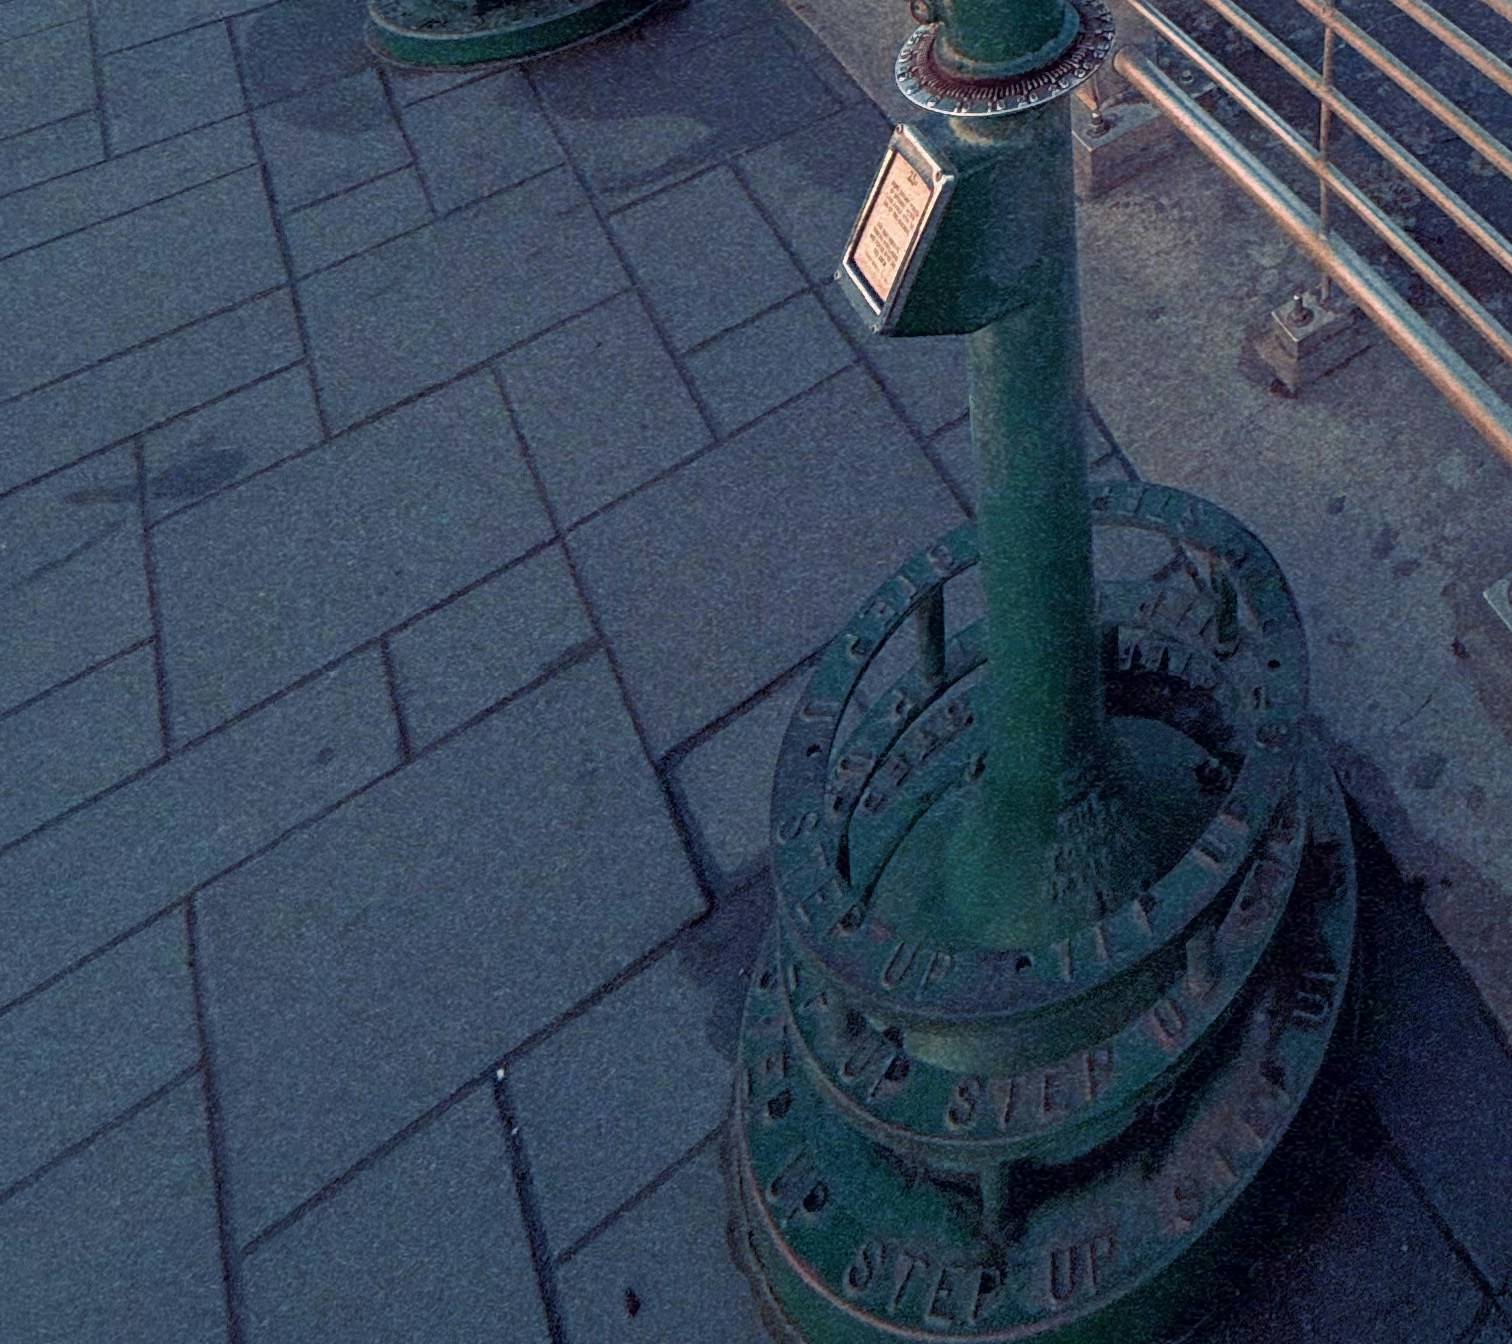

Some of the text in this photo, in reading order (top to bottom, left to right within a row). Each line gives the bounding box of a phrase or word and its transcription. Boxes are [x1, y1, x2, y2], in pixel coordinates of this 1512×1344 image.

[880, 940, 957, 1004] UP
[947, 1048, 1114, 1128] STEP
[843, 1240, 1010, 1327] STEP
[1046, 1230, 1118, 1314] UP
